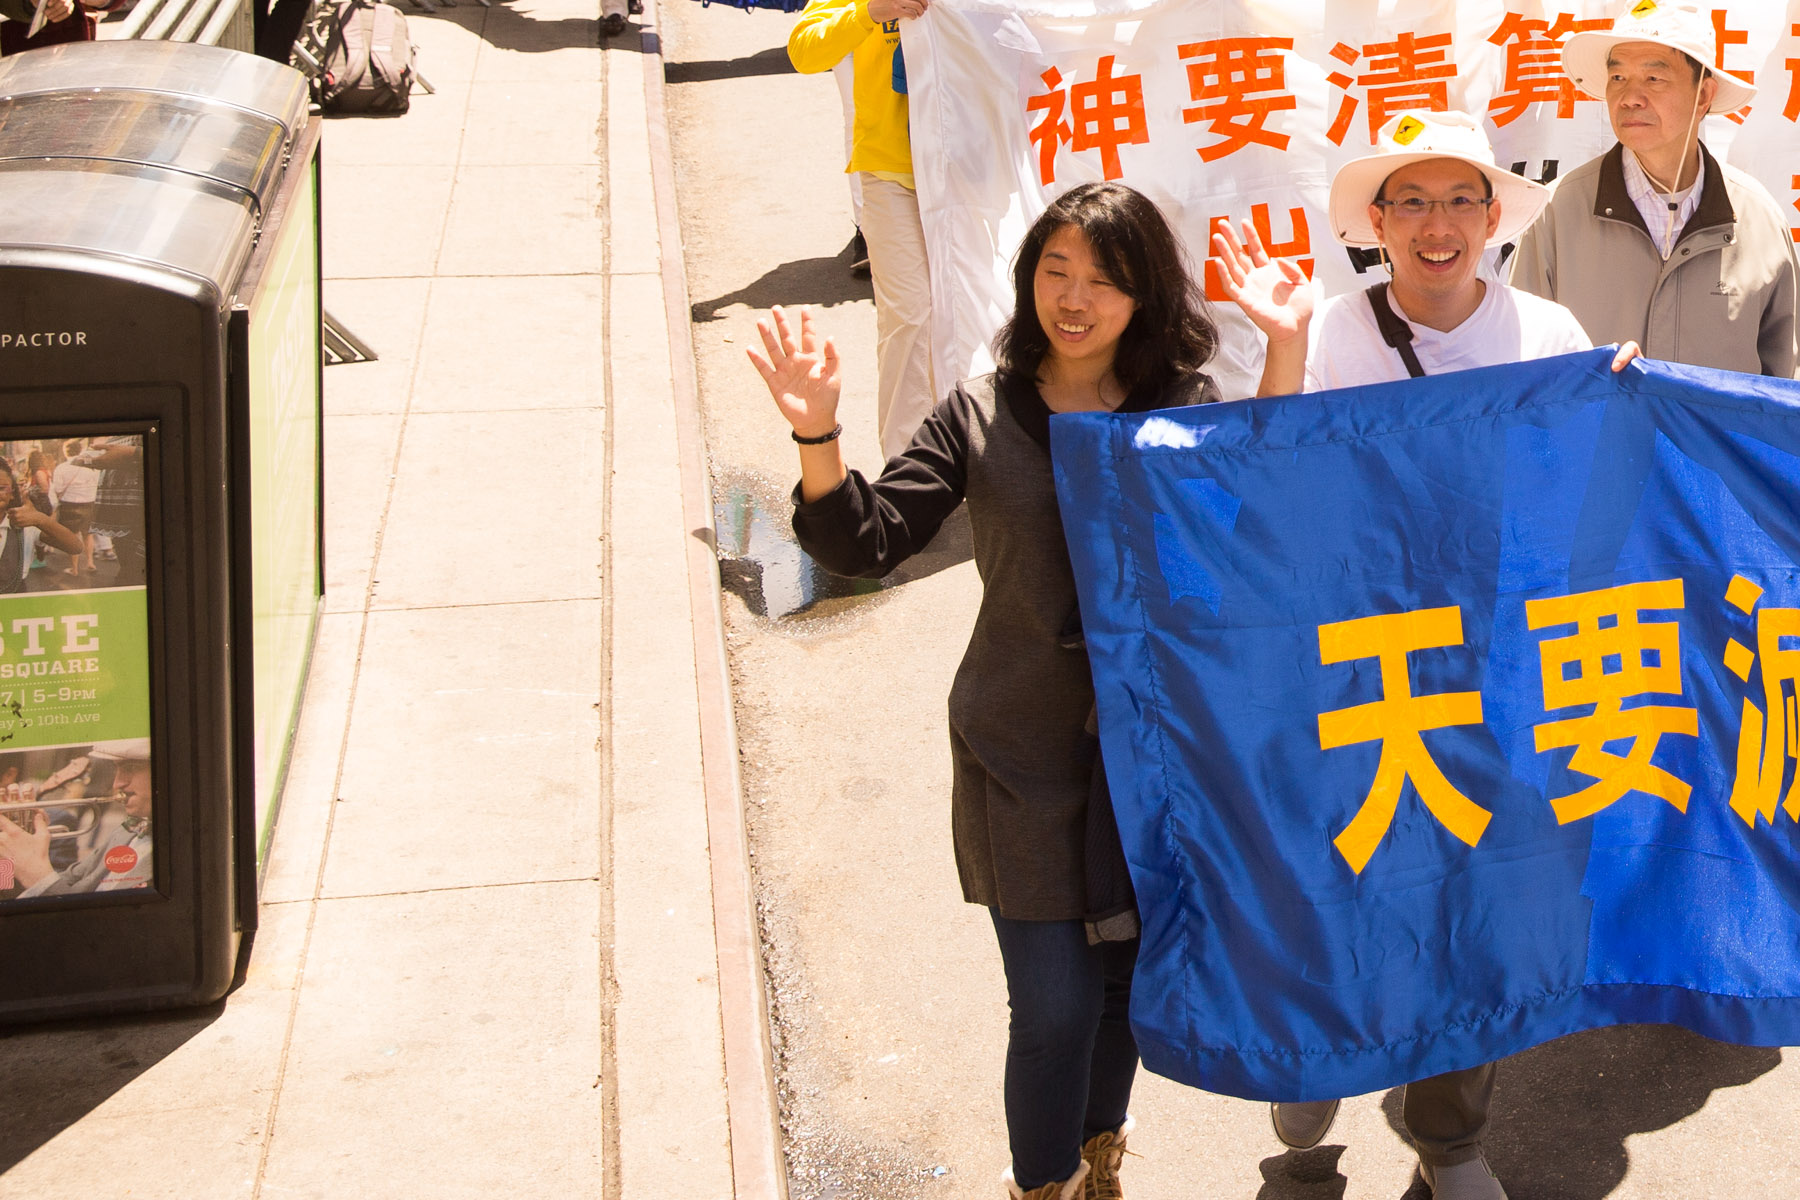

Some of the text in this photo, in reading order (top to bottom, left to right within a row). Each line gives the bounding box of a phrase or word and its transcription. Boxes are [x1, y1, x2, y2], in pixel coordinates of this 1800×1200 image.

[0, 330, 89, 348] PACTOR
[0, 613, 100, 657] TE
[0, 657, 100, 680] SQUARE
[37, 713, 70, 726] 10th
[74, 712, 101, 724] Ave
